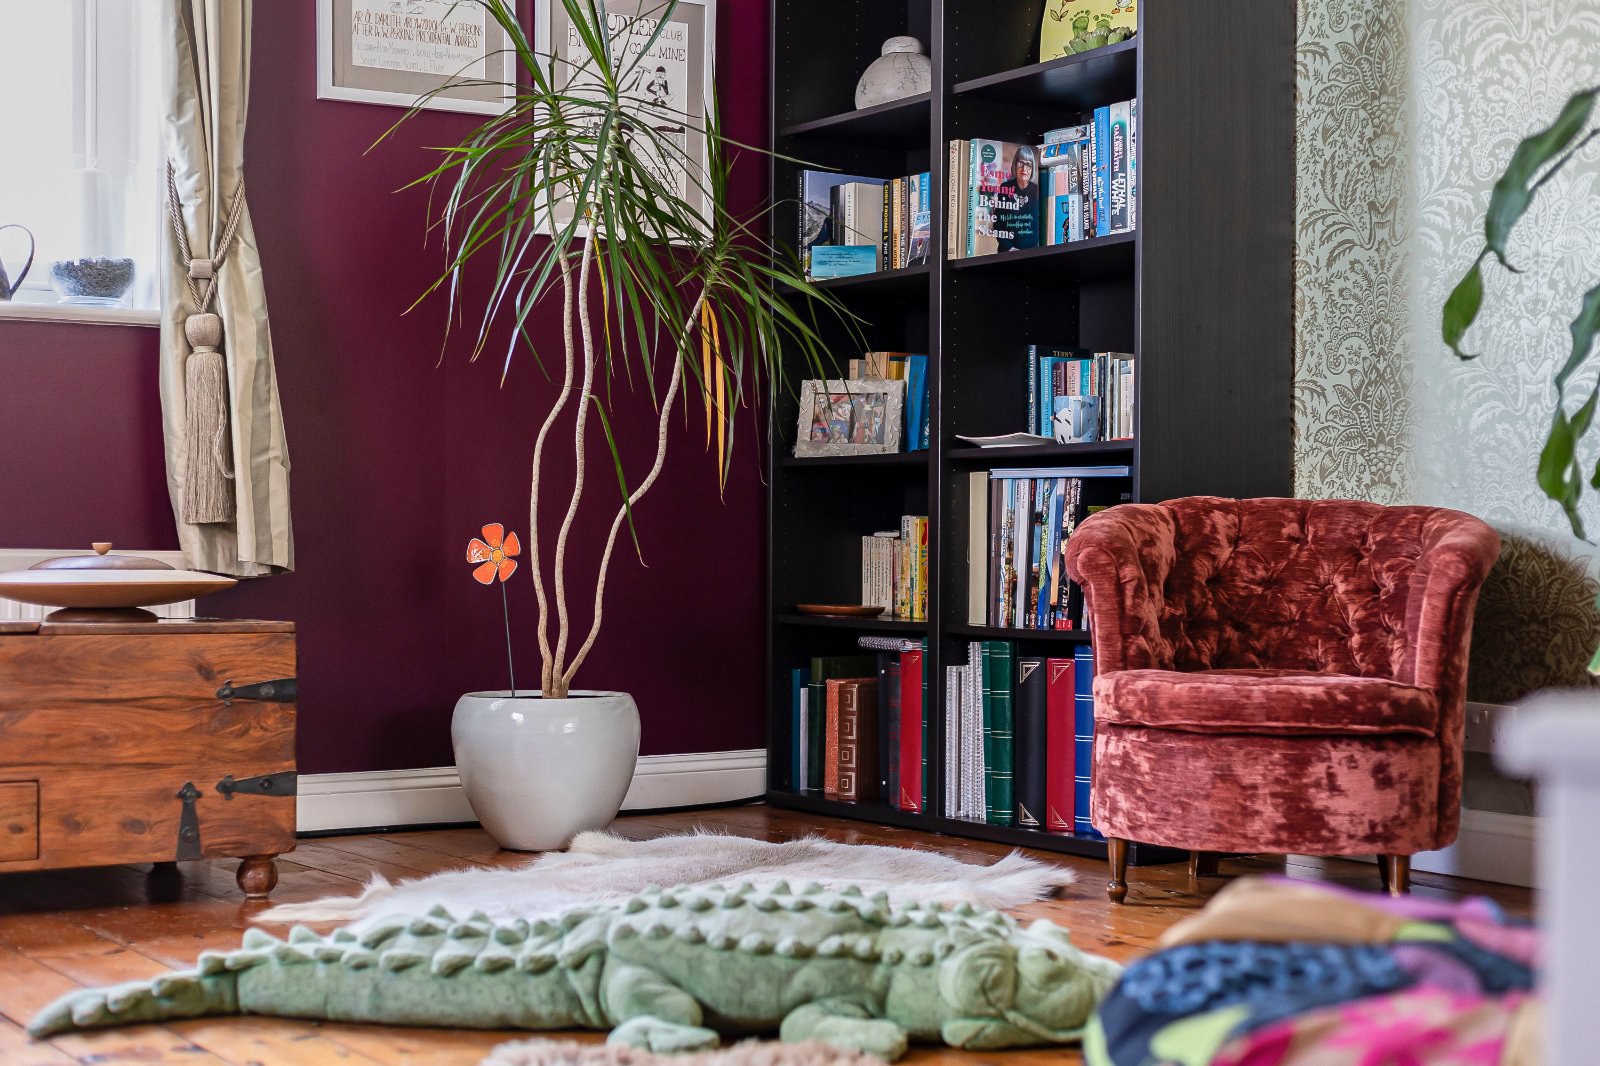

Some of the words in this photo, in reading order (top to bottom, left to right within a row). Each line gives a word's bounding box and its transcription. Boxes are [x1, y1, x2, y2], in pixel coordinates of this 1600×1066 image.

[661, 28, 683, 41] CLUB
[659, 46, 686, 62] MINE
[981, 180, 1016, 197] Young
[1118, 172, 1126, 210] LETHAL
[979, 195, 1020, 211] Behind
[1111, 177, 1120, 217] WHITE
[978, 213, 998, 223] the
[978, 227, 1015, 240] Seams
